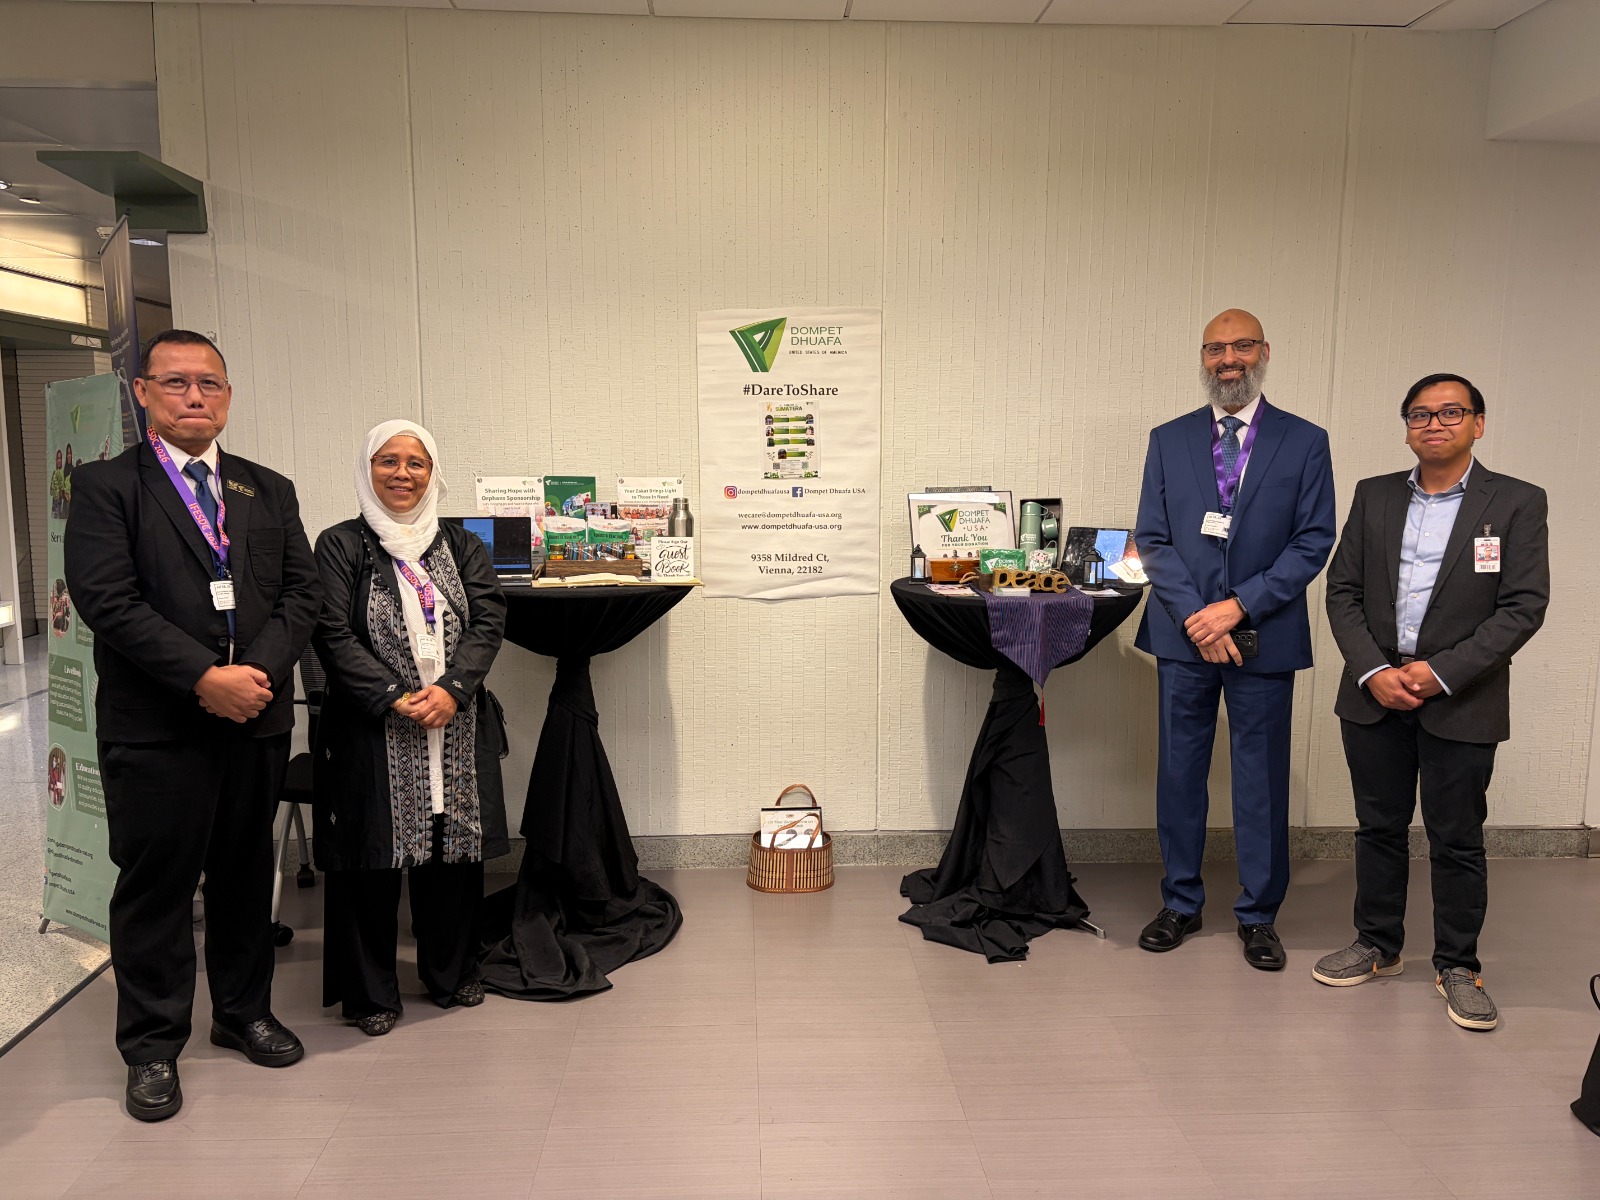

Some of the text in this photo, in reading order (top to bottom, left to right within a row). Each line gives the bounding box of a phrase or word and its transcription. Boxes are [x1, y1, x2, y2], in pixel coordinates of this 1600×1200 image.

[790, 326, 843, 335] DOMPET
[790, 336, 842, 346] DHUAFA
[742, 383, 839, 396] #DareToShare
[154, 444, 171, 463] 2026
[737, 488, 790, 496] dompetdhuafausa
[804, 488, 828, 496] Dompet
[829, 487, 851, 495] Dhuafa
[189, 502, 211, 531] IFESDC
[738, 511, 842, 519] wecare@dompetdhuafa-usa.org
[959, 517, 991, 525] DHUAFA
[741, 523, 842, 531] www.dompetdhuafa-usa.org
[940, 533, 989, 543] Thank You
[750, 553, 830, 563] 9358 Mildred Ct,
[758, 565, 823, 575] Vienna, 22182
[401, 565, 422, 589] IFESDC
[989, 567, 1067, 593] peace
